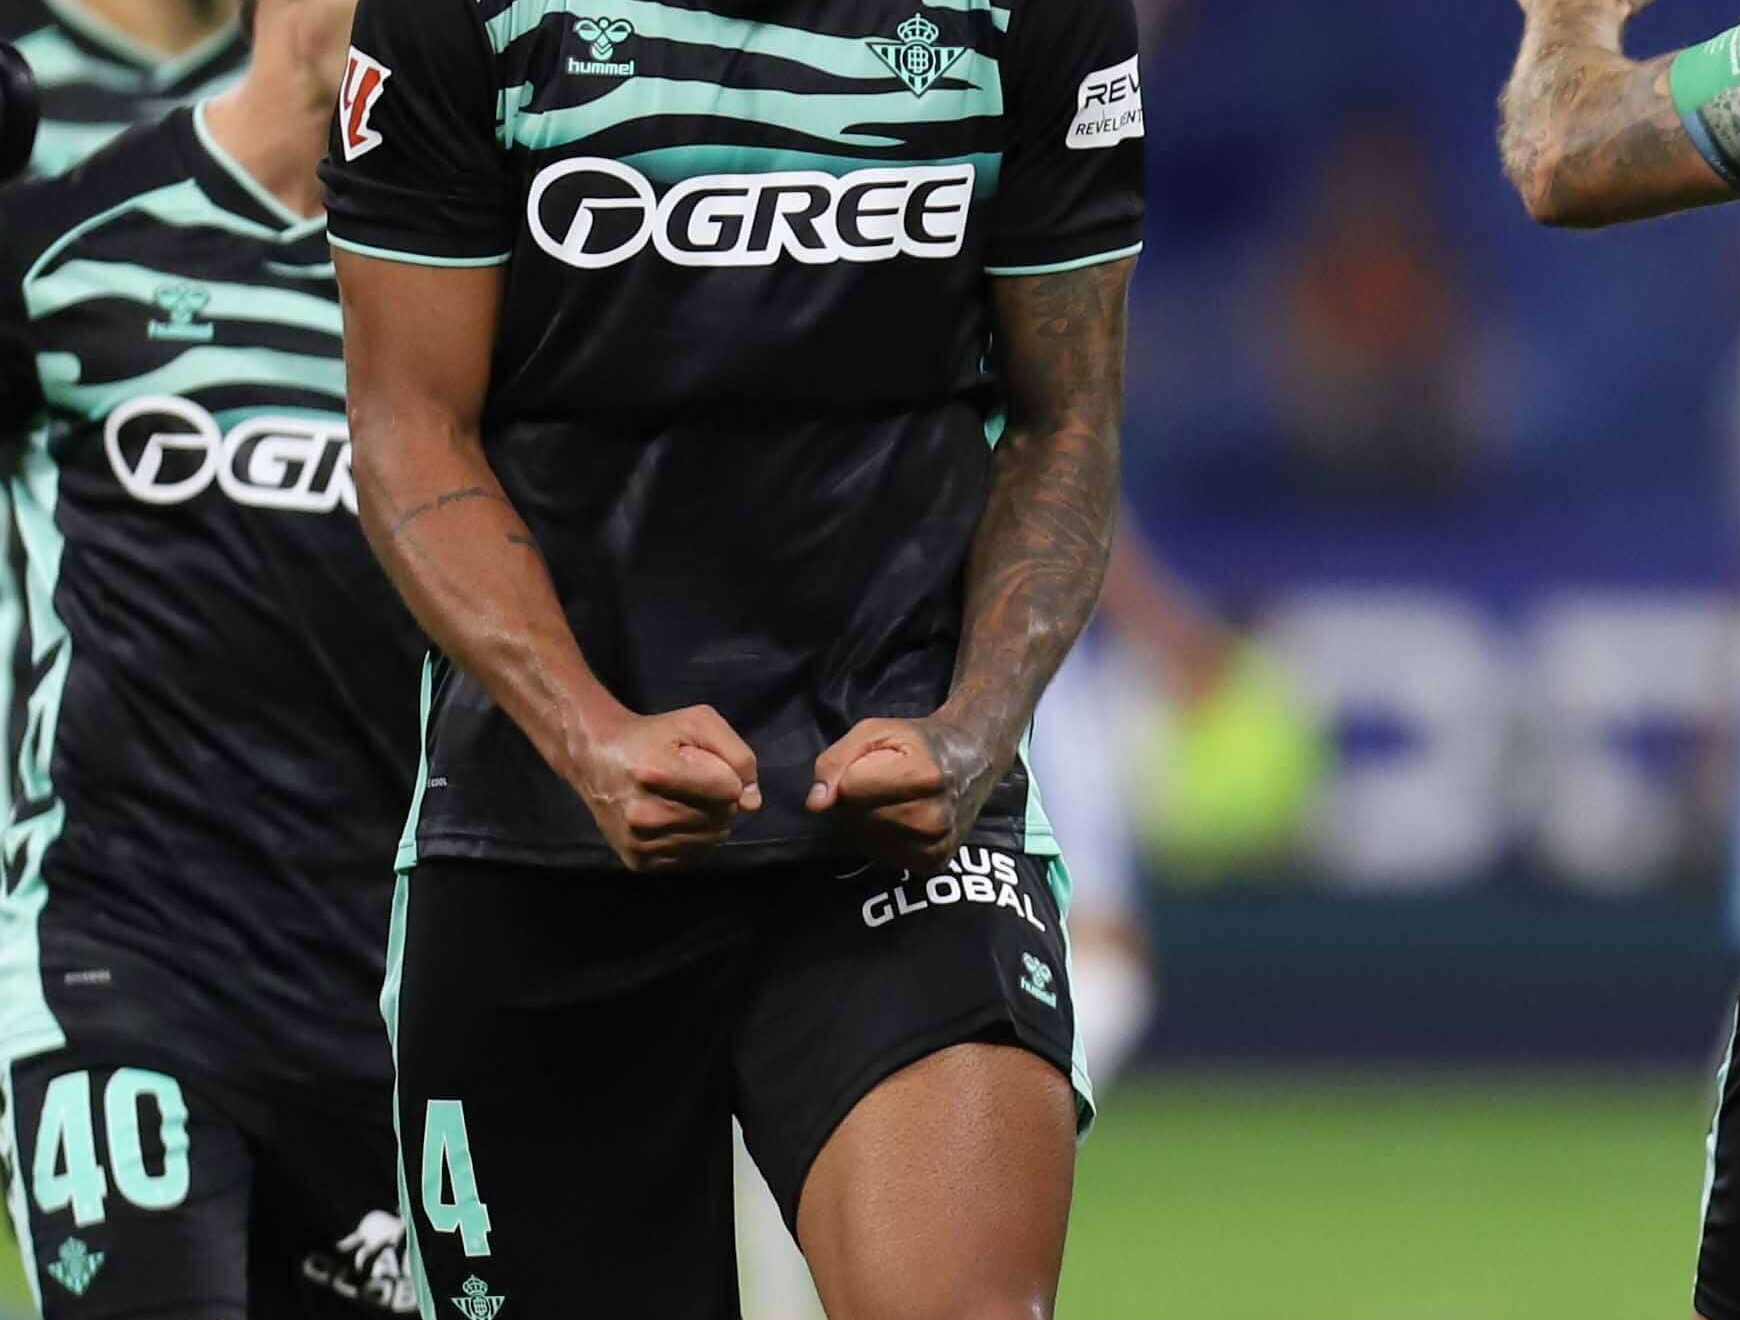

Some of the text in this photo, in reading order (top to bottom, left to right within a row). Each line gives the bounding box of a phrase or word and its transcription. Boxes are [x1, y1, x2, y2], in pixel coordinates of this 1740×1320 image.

[567, 58, 635, 77] hummel
[663, 175, 970, 255] GREE
[949, 845, 1019, 886] US
[861, 874, 1046, 933] GLOBAL
[33, 1066, 191, 1228] 40
[422, 1098, 491, 1256] 4
